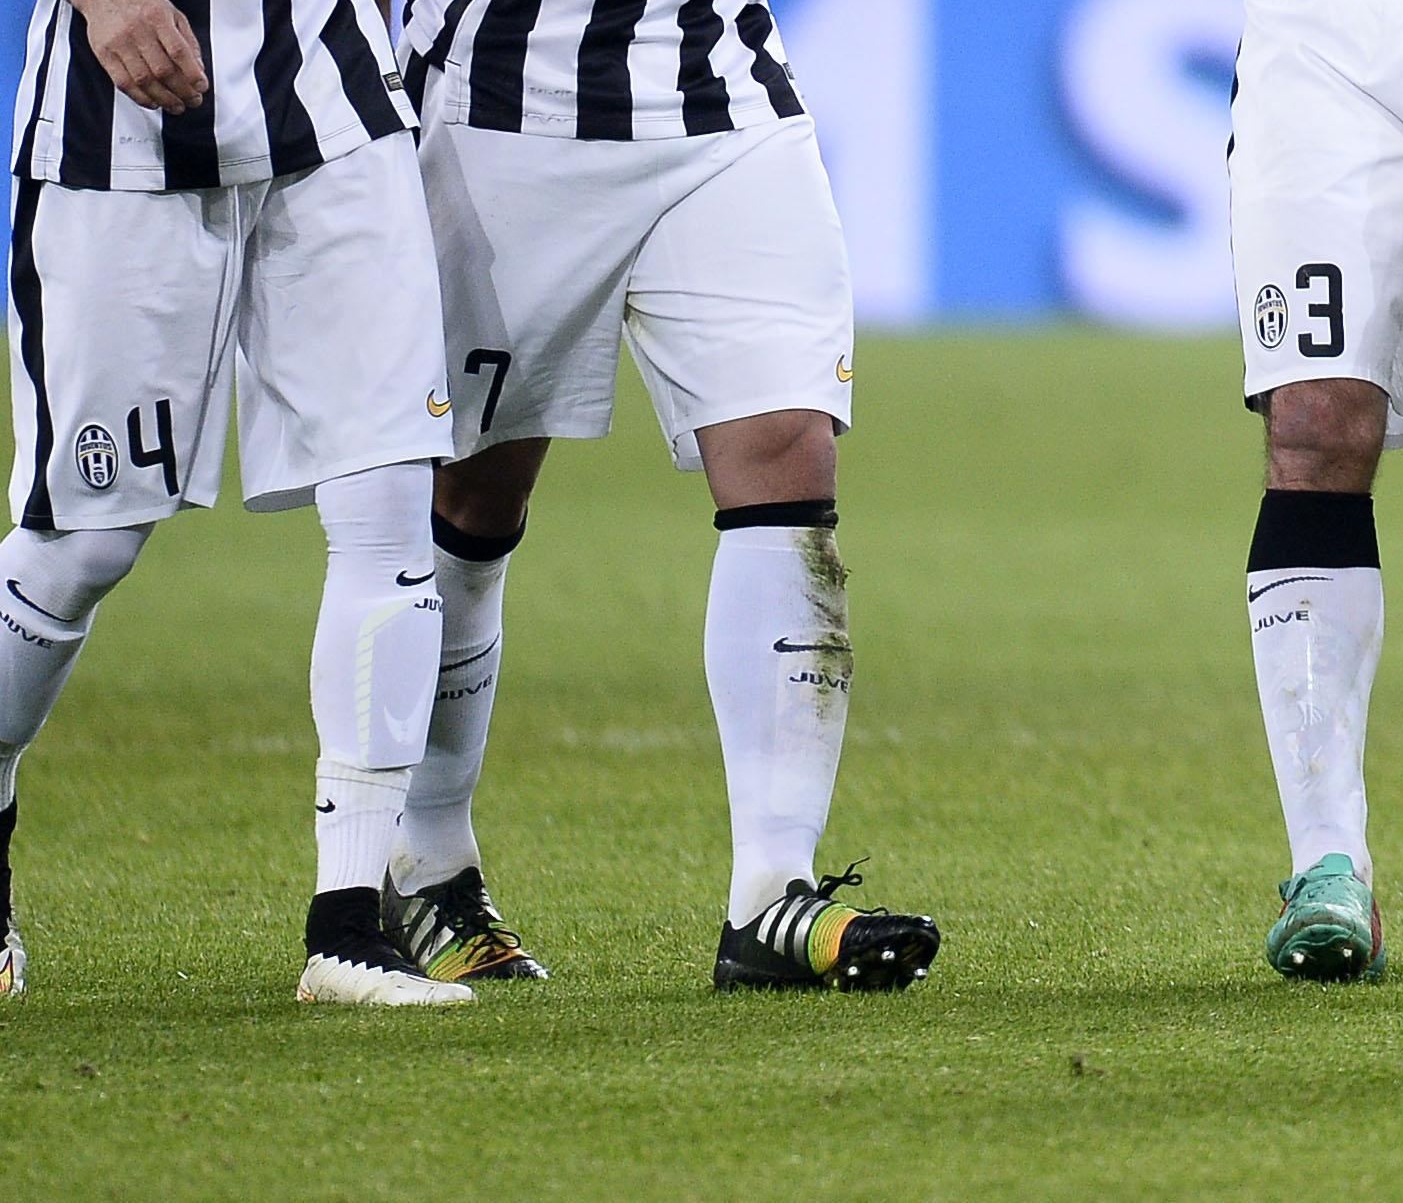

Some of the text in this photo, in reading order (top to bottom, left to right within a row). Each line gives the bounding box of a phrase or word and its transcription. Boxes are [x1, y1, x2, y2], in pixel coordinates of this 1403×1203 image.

[1295, 262, 1345, 358] 3
[463, 347, 512, 435] 7
[126, 398, 181, 498] 4
[1254, 609, 1310, 634] JUVE
[788, 671, 850, 694] JUVE
